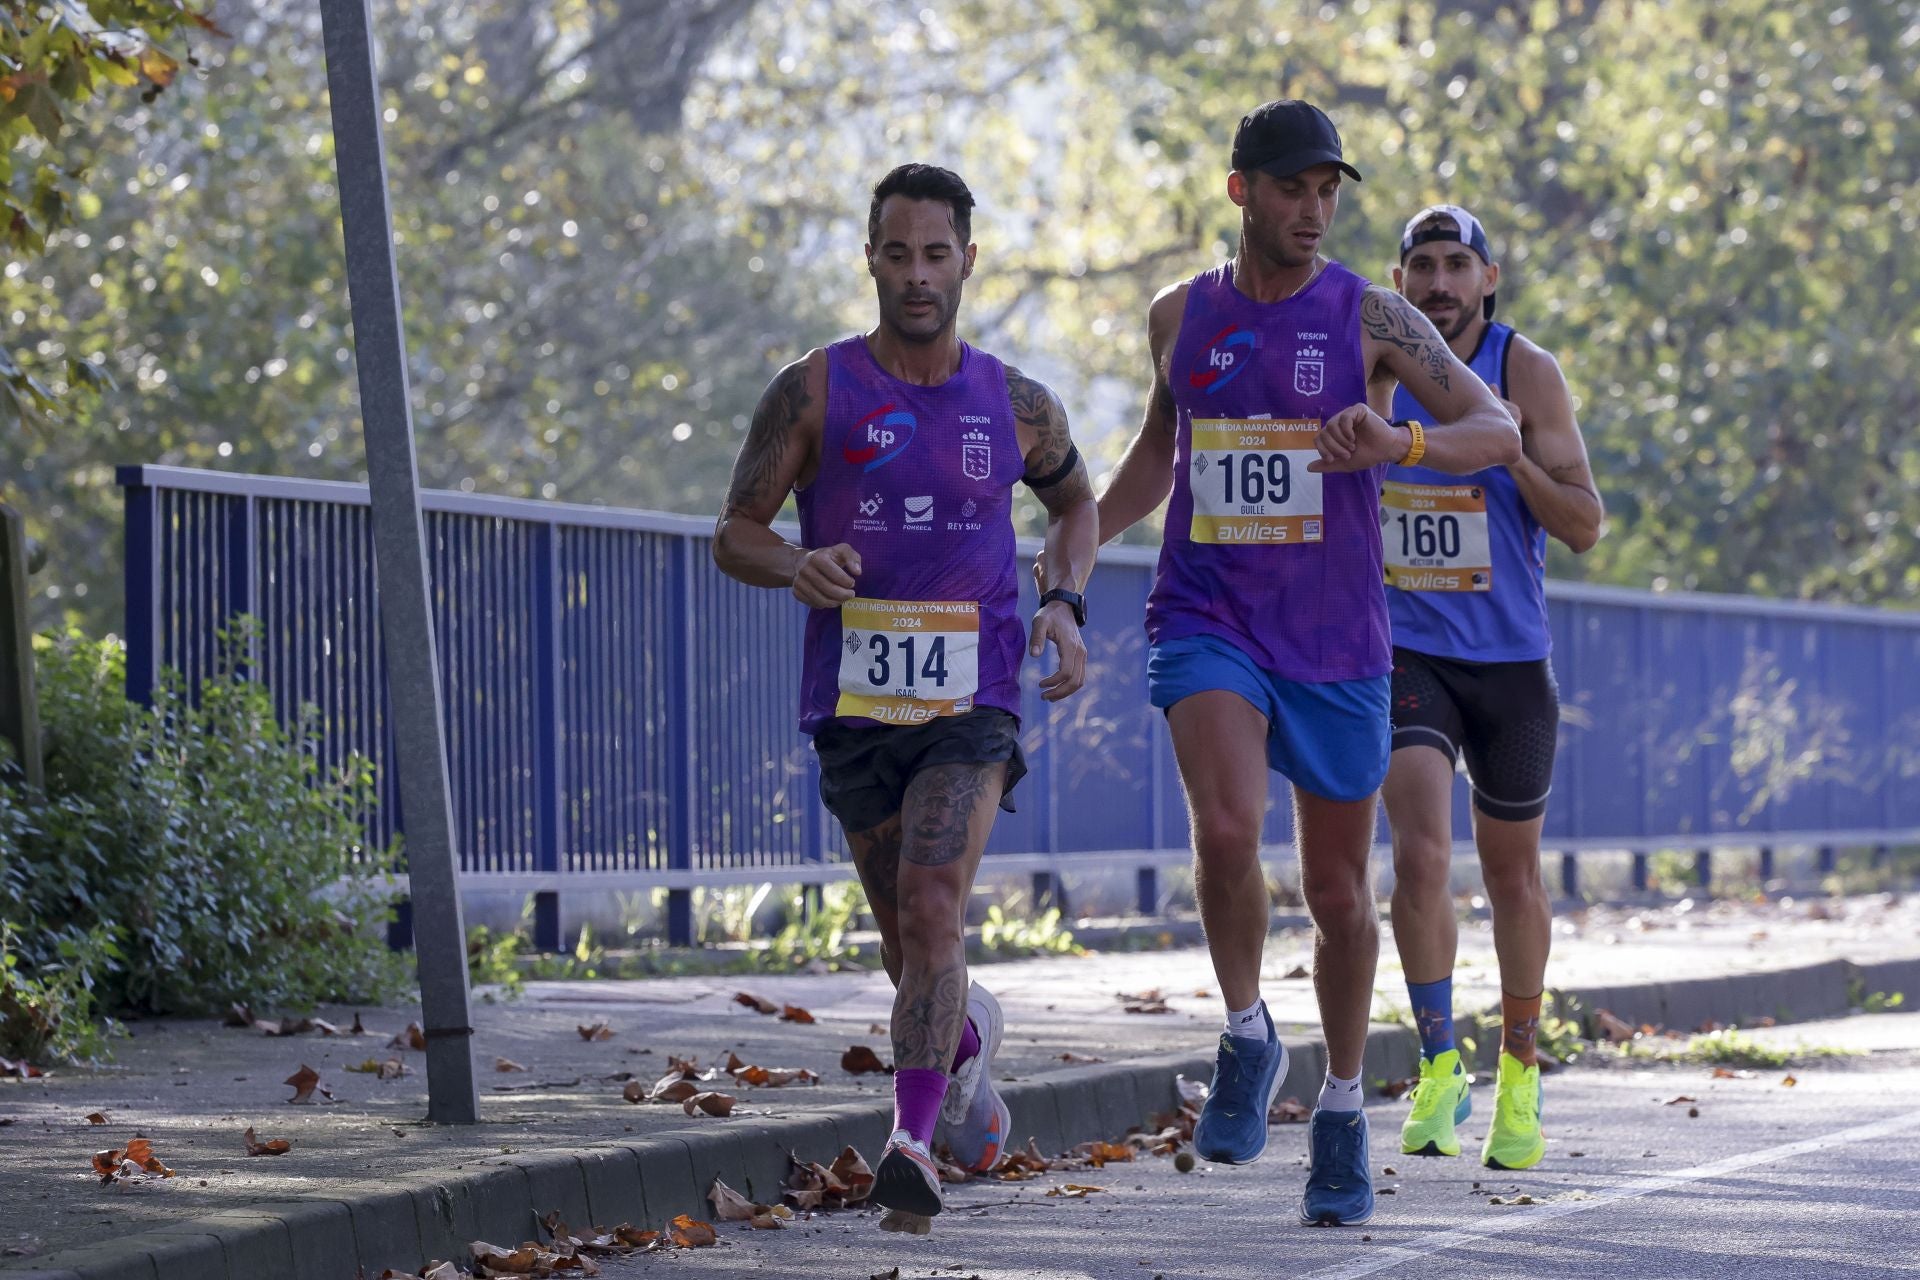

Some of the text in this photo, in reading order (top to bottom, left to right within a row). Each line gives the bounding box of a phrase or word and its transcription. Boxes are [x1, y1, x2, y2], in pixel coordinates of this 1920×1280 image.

[1297, 332, 1328, 341] VESKIN
[1210, 348, 1234, 370] kp
[959, 415, 991, 425] VESKIN
[1216, 423, 1241, 432] MEDIA
[1243, 421, 1286, 432] MARATÓN
[1287, 421, 1319, 432] AVILÉS
[867, 424, 895, 448] kp
[1240, 436, 1266, 446] 2024
[1217, 453, 1291, 504] 169
[1411, 499, 1436, 508] 2024
[1240, 505, 1265, 515] GUILLE
[947, 522, 963, 530] REY
[1218, 522, 1288, 540] avilés
[1397, 513, 1460, 558] 160
[869, 603, 895, 613] MEDIA
[896, 603, 944, 613] MARATÓN
[945, 602, 976, 613] AVILÉS
[892, 617, 922, 628] 2024
[867, 634, 949, 687] 314
[895, 688, 917, 699] ISAAC
[870, 703, 941, 722] avilés
